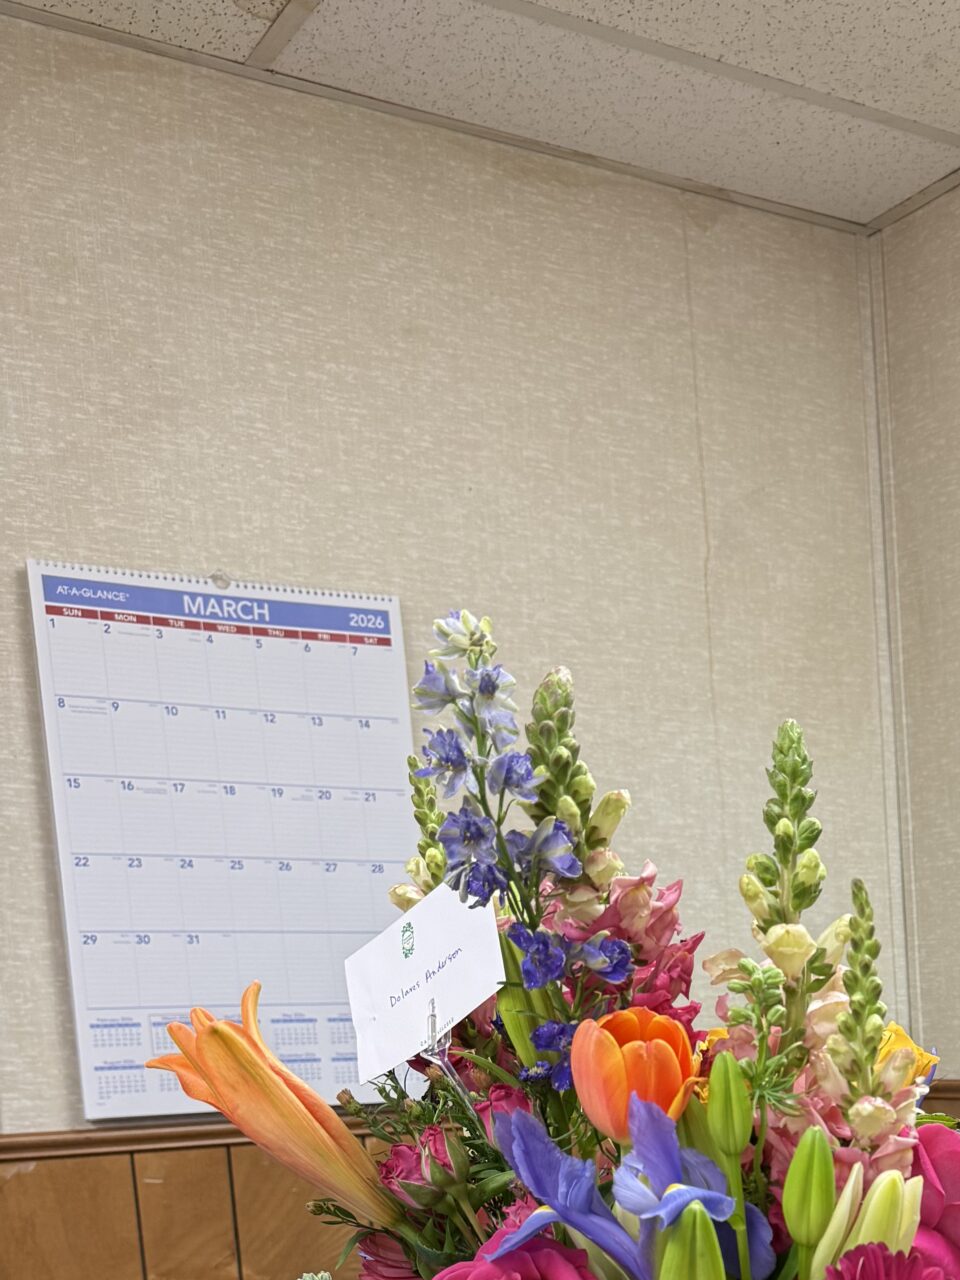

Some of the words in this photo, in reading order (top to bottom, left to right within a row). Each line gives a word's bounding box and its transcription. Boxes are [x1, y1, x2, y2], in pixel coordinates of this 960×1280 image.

[62, 608, 82, 617] SUN
[114, 614, 137, 622] MON
[168, 619, 185, 628] TUE
[216, 625, 237, 633] WED
[267, 629, 285, 637] THU
[317, 633, 331, 641] FRI
[363, 637, 379, 645] SAT
[183, 595, 270, 622] MARCH
[348, 613, 385, 629] 2026
[49, 618, 56, 629] 1
[103, 623, 111, 634] 2
[155, 629, 163, 639] 3
[206, 634, 214, 643] 4
[255, 639, 263, 649] 5
[304, 643, 311, 653] 6
[351, 647, 358, 656] 7
[57, 697, 66, 708] 8
[111, 701, 119, 712] 9
[165, 706, 178, 716] 10
[215, 710, 227, 719] 11
[263, 713, 276, 723] 12
[311, 716, 323, 726] 13
[358, 719, 371, 729] 14
[66, 778, 81, 788] 15
[120, 781, 134, 791] 16
[172, 783, 185, 793] 17
[223, 785, 236, 795] 18
[271, 788, 284, 798] 19
[317, 790, 332, 800] 20
[364, 792, 377, 802] 21
[74, 857, 90, 867] 22
[127, 858, 142, 868] 23
[180, 859, 194, 869] 24
[230, 860, 244, 870] 25
[278, 861, 292, 871] 26
[325, 863, 338, 872] 27
[371, 864, 384, 873] 28
[82, 934, 97, 945] 29
[136, 934, 150, 944] 30
[187, 935, 200, 944] 31
[425, 947, 463, 983] Anderson
